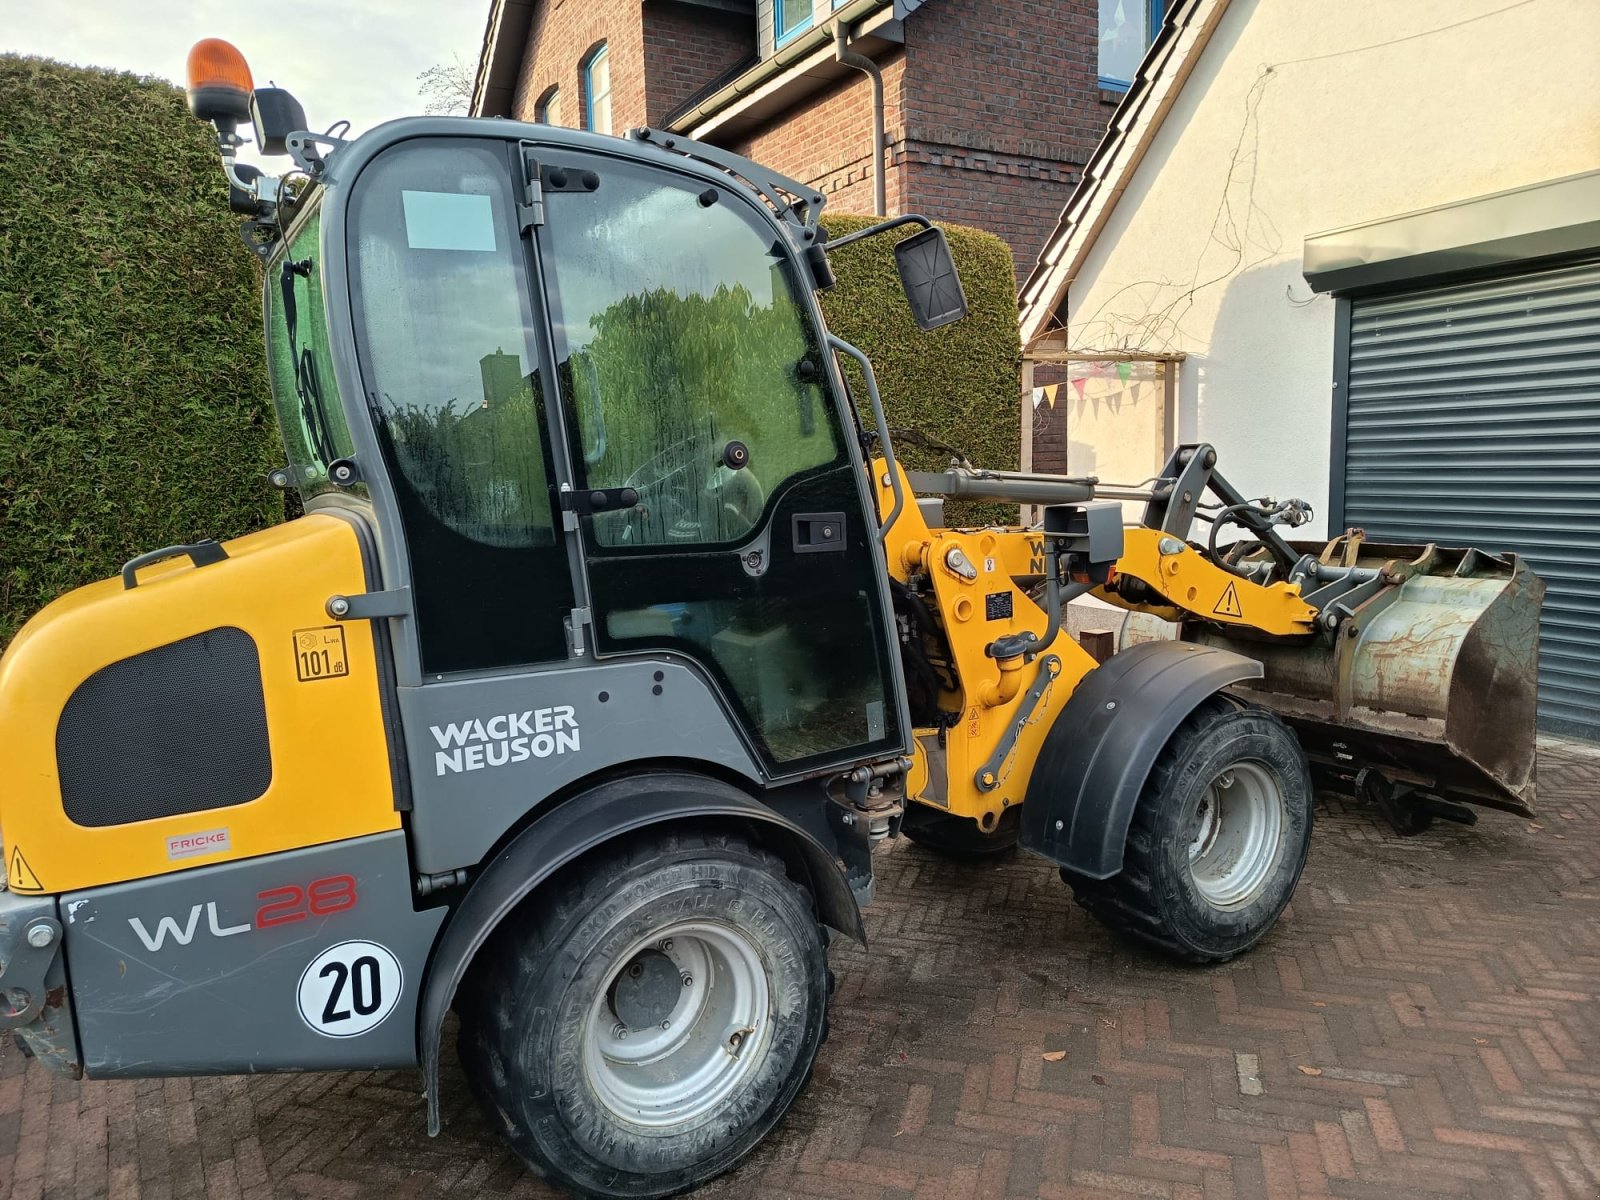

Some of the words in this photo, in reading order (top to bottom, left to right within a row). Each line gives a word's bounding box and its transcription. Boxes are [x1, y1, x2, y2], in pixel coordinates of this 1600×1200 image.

[300, 649, 330, 677] 101
[333, 661, 344, 673] dB
[429, 705, 579, 749] WACKER
[435, 728, 581, 776] NEUSON
[170, 832, 226, 851] FRICKE
[318, 955, 382, 1025] 20
